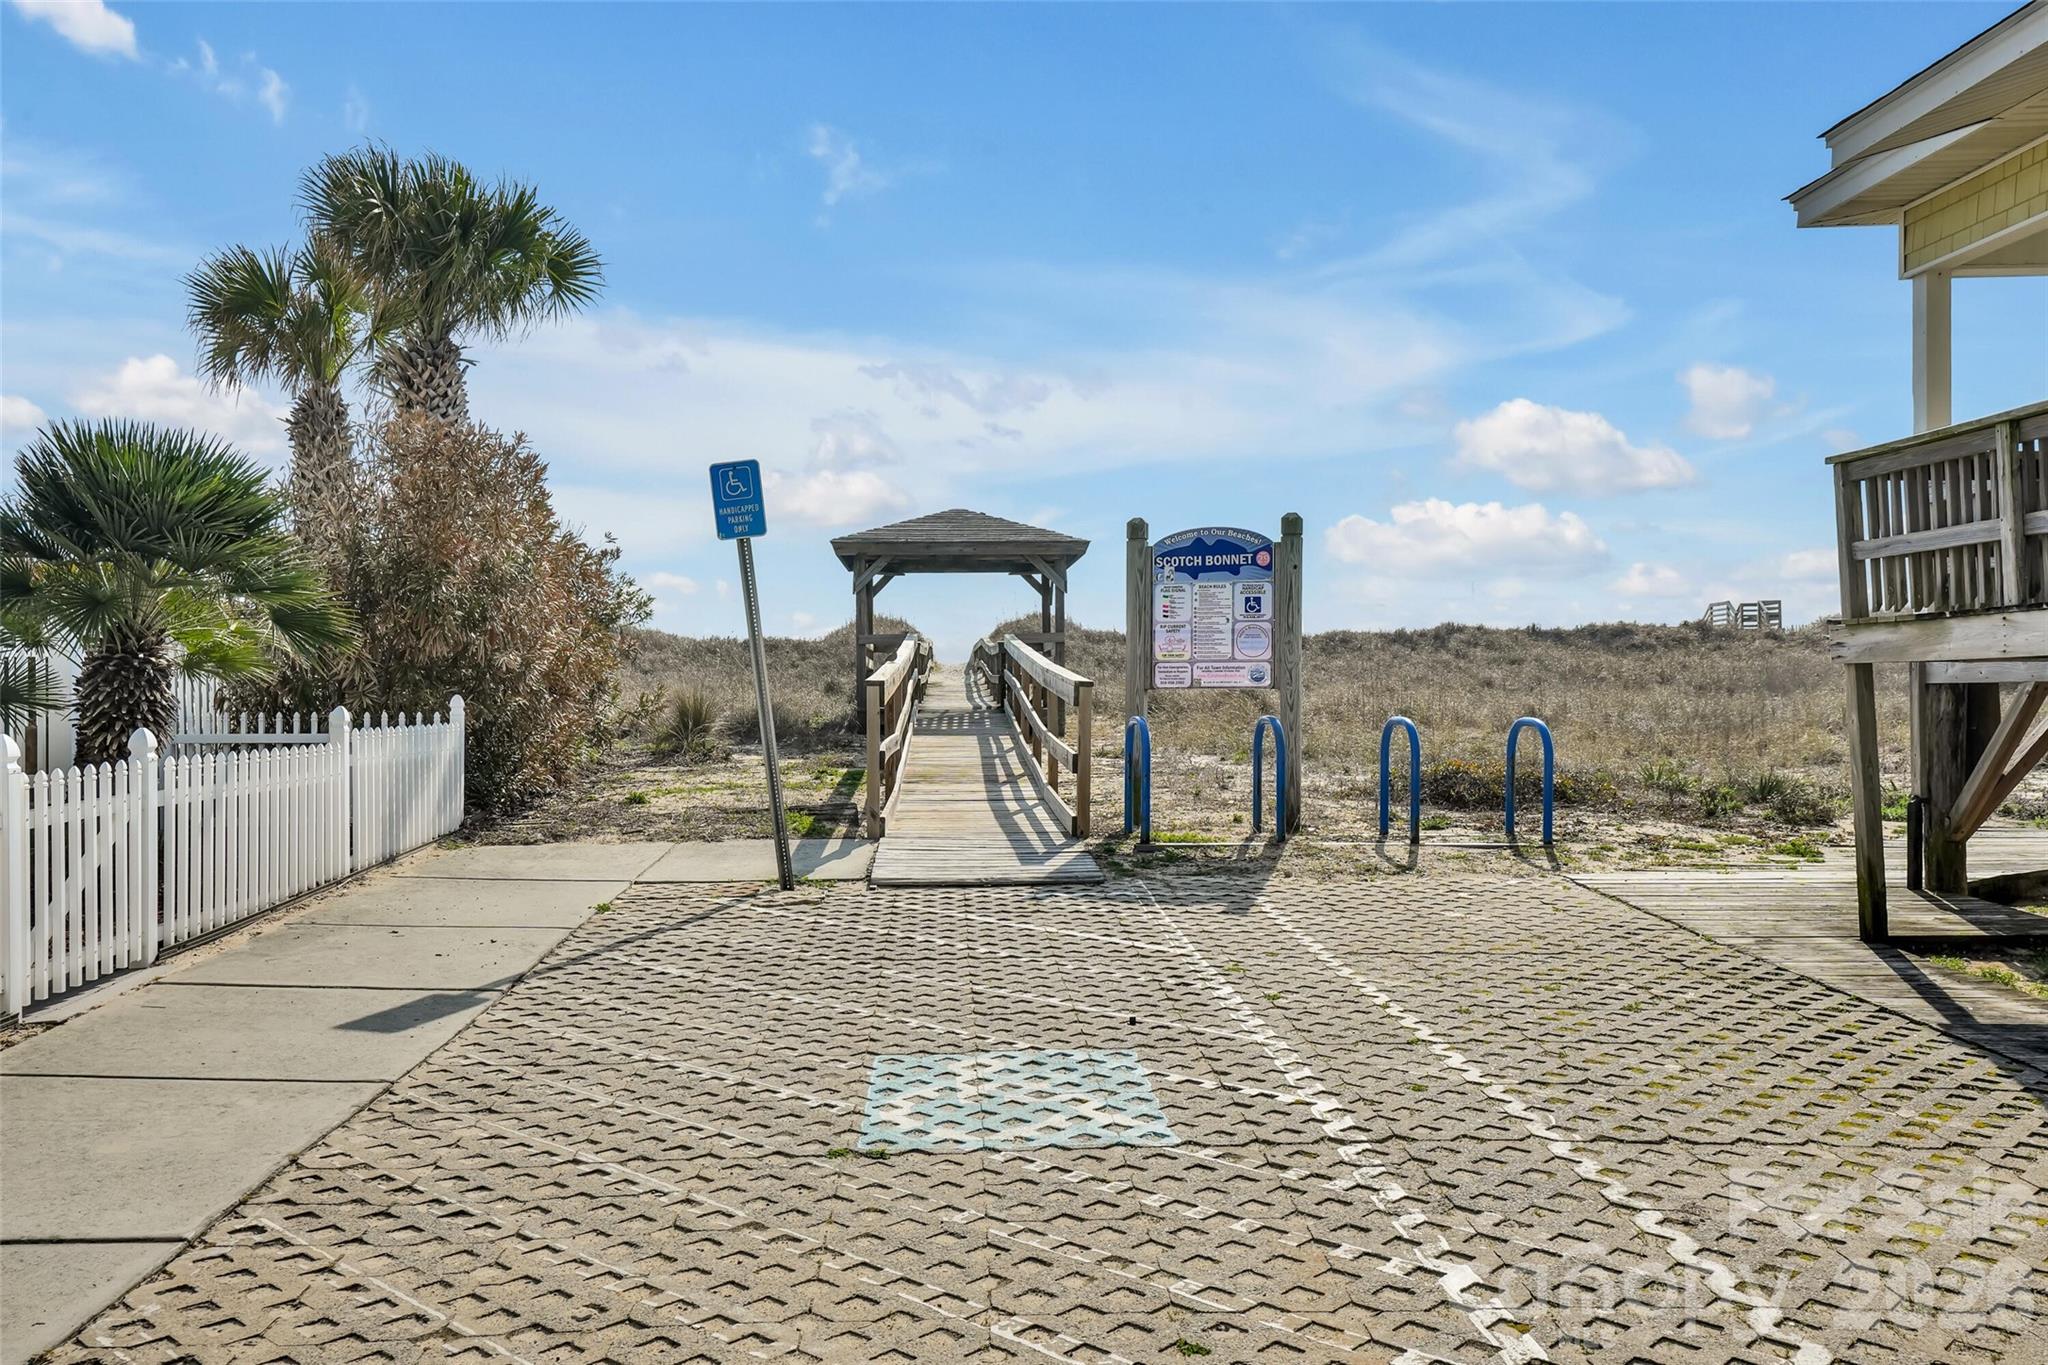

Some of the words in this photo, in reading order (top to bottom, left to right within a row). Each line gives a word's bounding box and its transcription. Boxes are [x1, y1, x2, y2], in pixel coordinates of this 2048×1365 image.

[719, 504, 759, 515] HANDICAPPED
[728, 514, 753, 524] PARKING
[734, 525, 749, 534] ONLY
[1164, 531, 1198, 546] Welcome
[1211, 528, 1225, 536] Our
[1227, 529, 1263, 546] Beaches!
[1155, 556, 1202, 568] SCOTCH
[1205, 553, 1254, 567] BONNET
